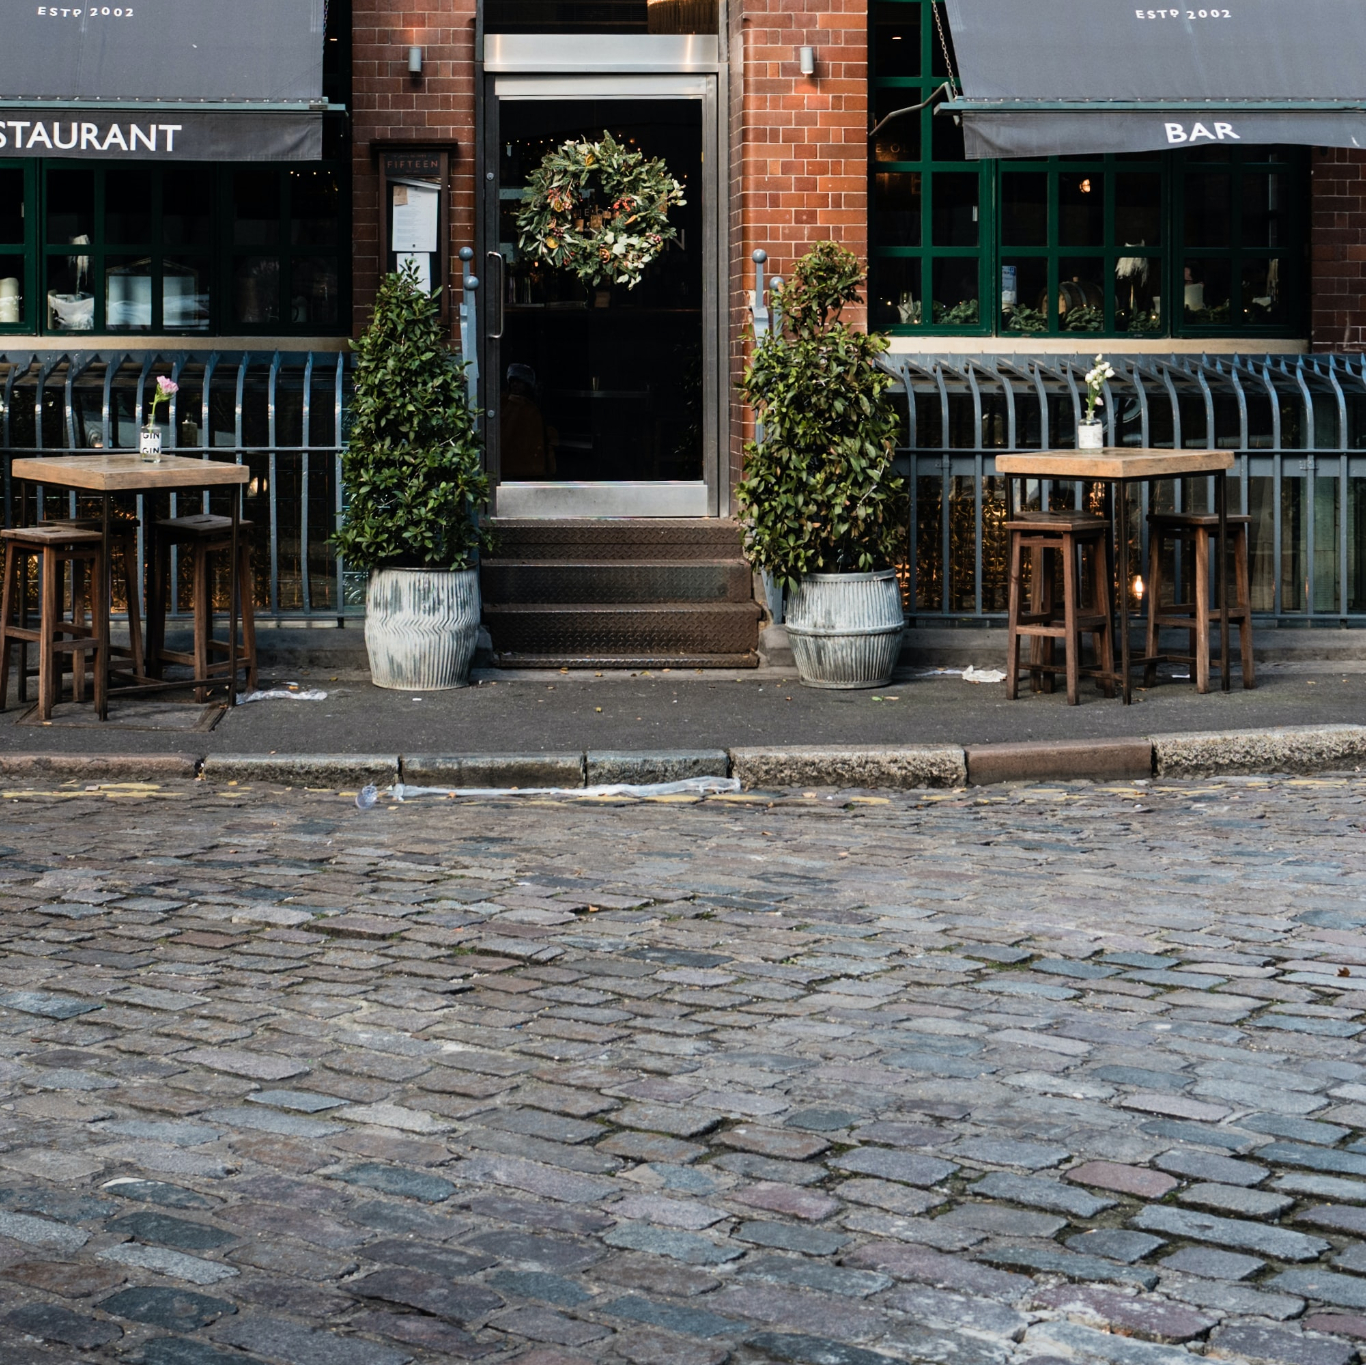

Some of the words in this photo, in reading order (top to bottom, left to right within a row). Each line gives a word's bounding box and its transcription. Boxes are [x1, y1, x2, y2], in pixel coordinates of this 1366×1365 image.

[89, 6, 134, 17] 2002
[1185, 9, 1232, 20] 2002
[1164, 122, 1241, 144] BAR
[387, 161, 438, 169] FIFTEEN
